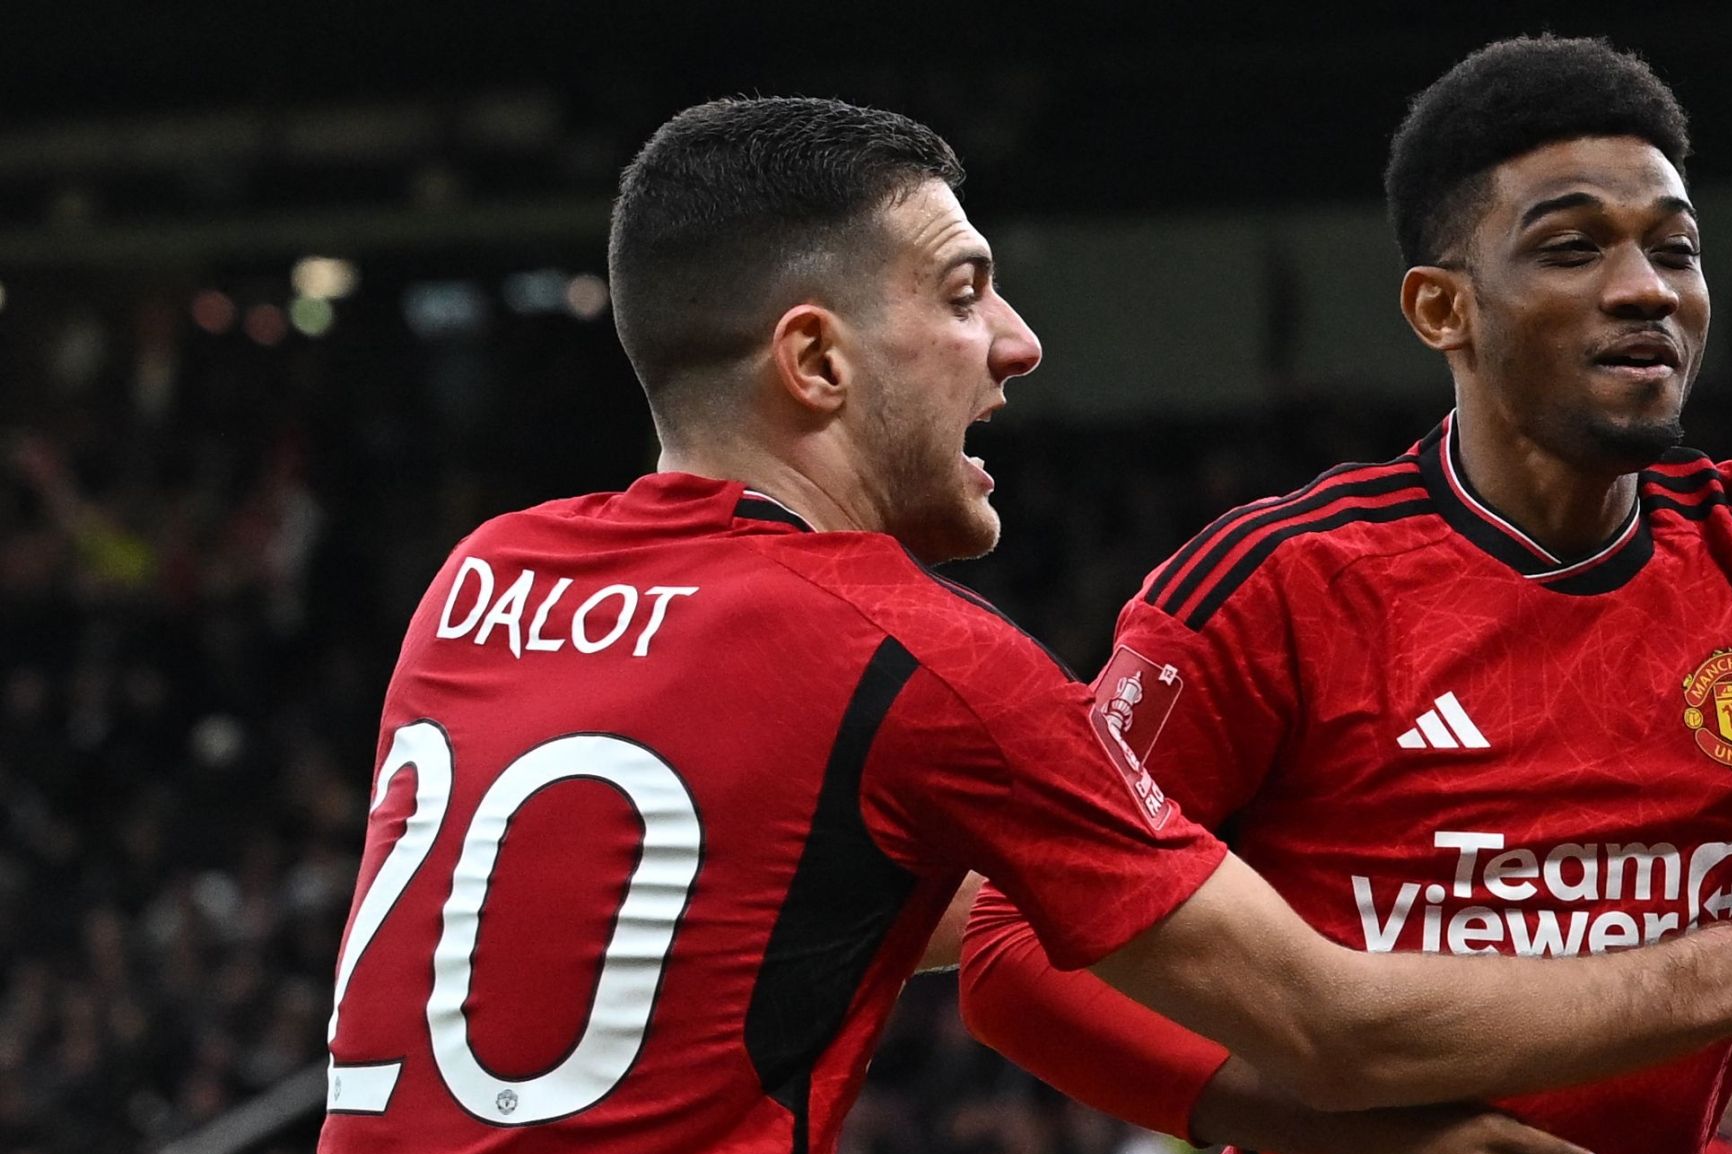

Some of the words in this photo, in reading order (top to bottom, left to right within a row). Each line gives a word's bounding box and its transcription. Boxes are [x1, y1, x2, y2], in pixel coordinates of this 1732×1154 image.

[435, 556, 700, 659] DALOT
[1434, 831, 1681, 902] Team
[326, 717, 707, 1128] 20
[1351, 875, 1680, 958] Viewer
